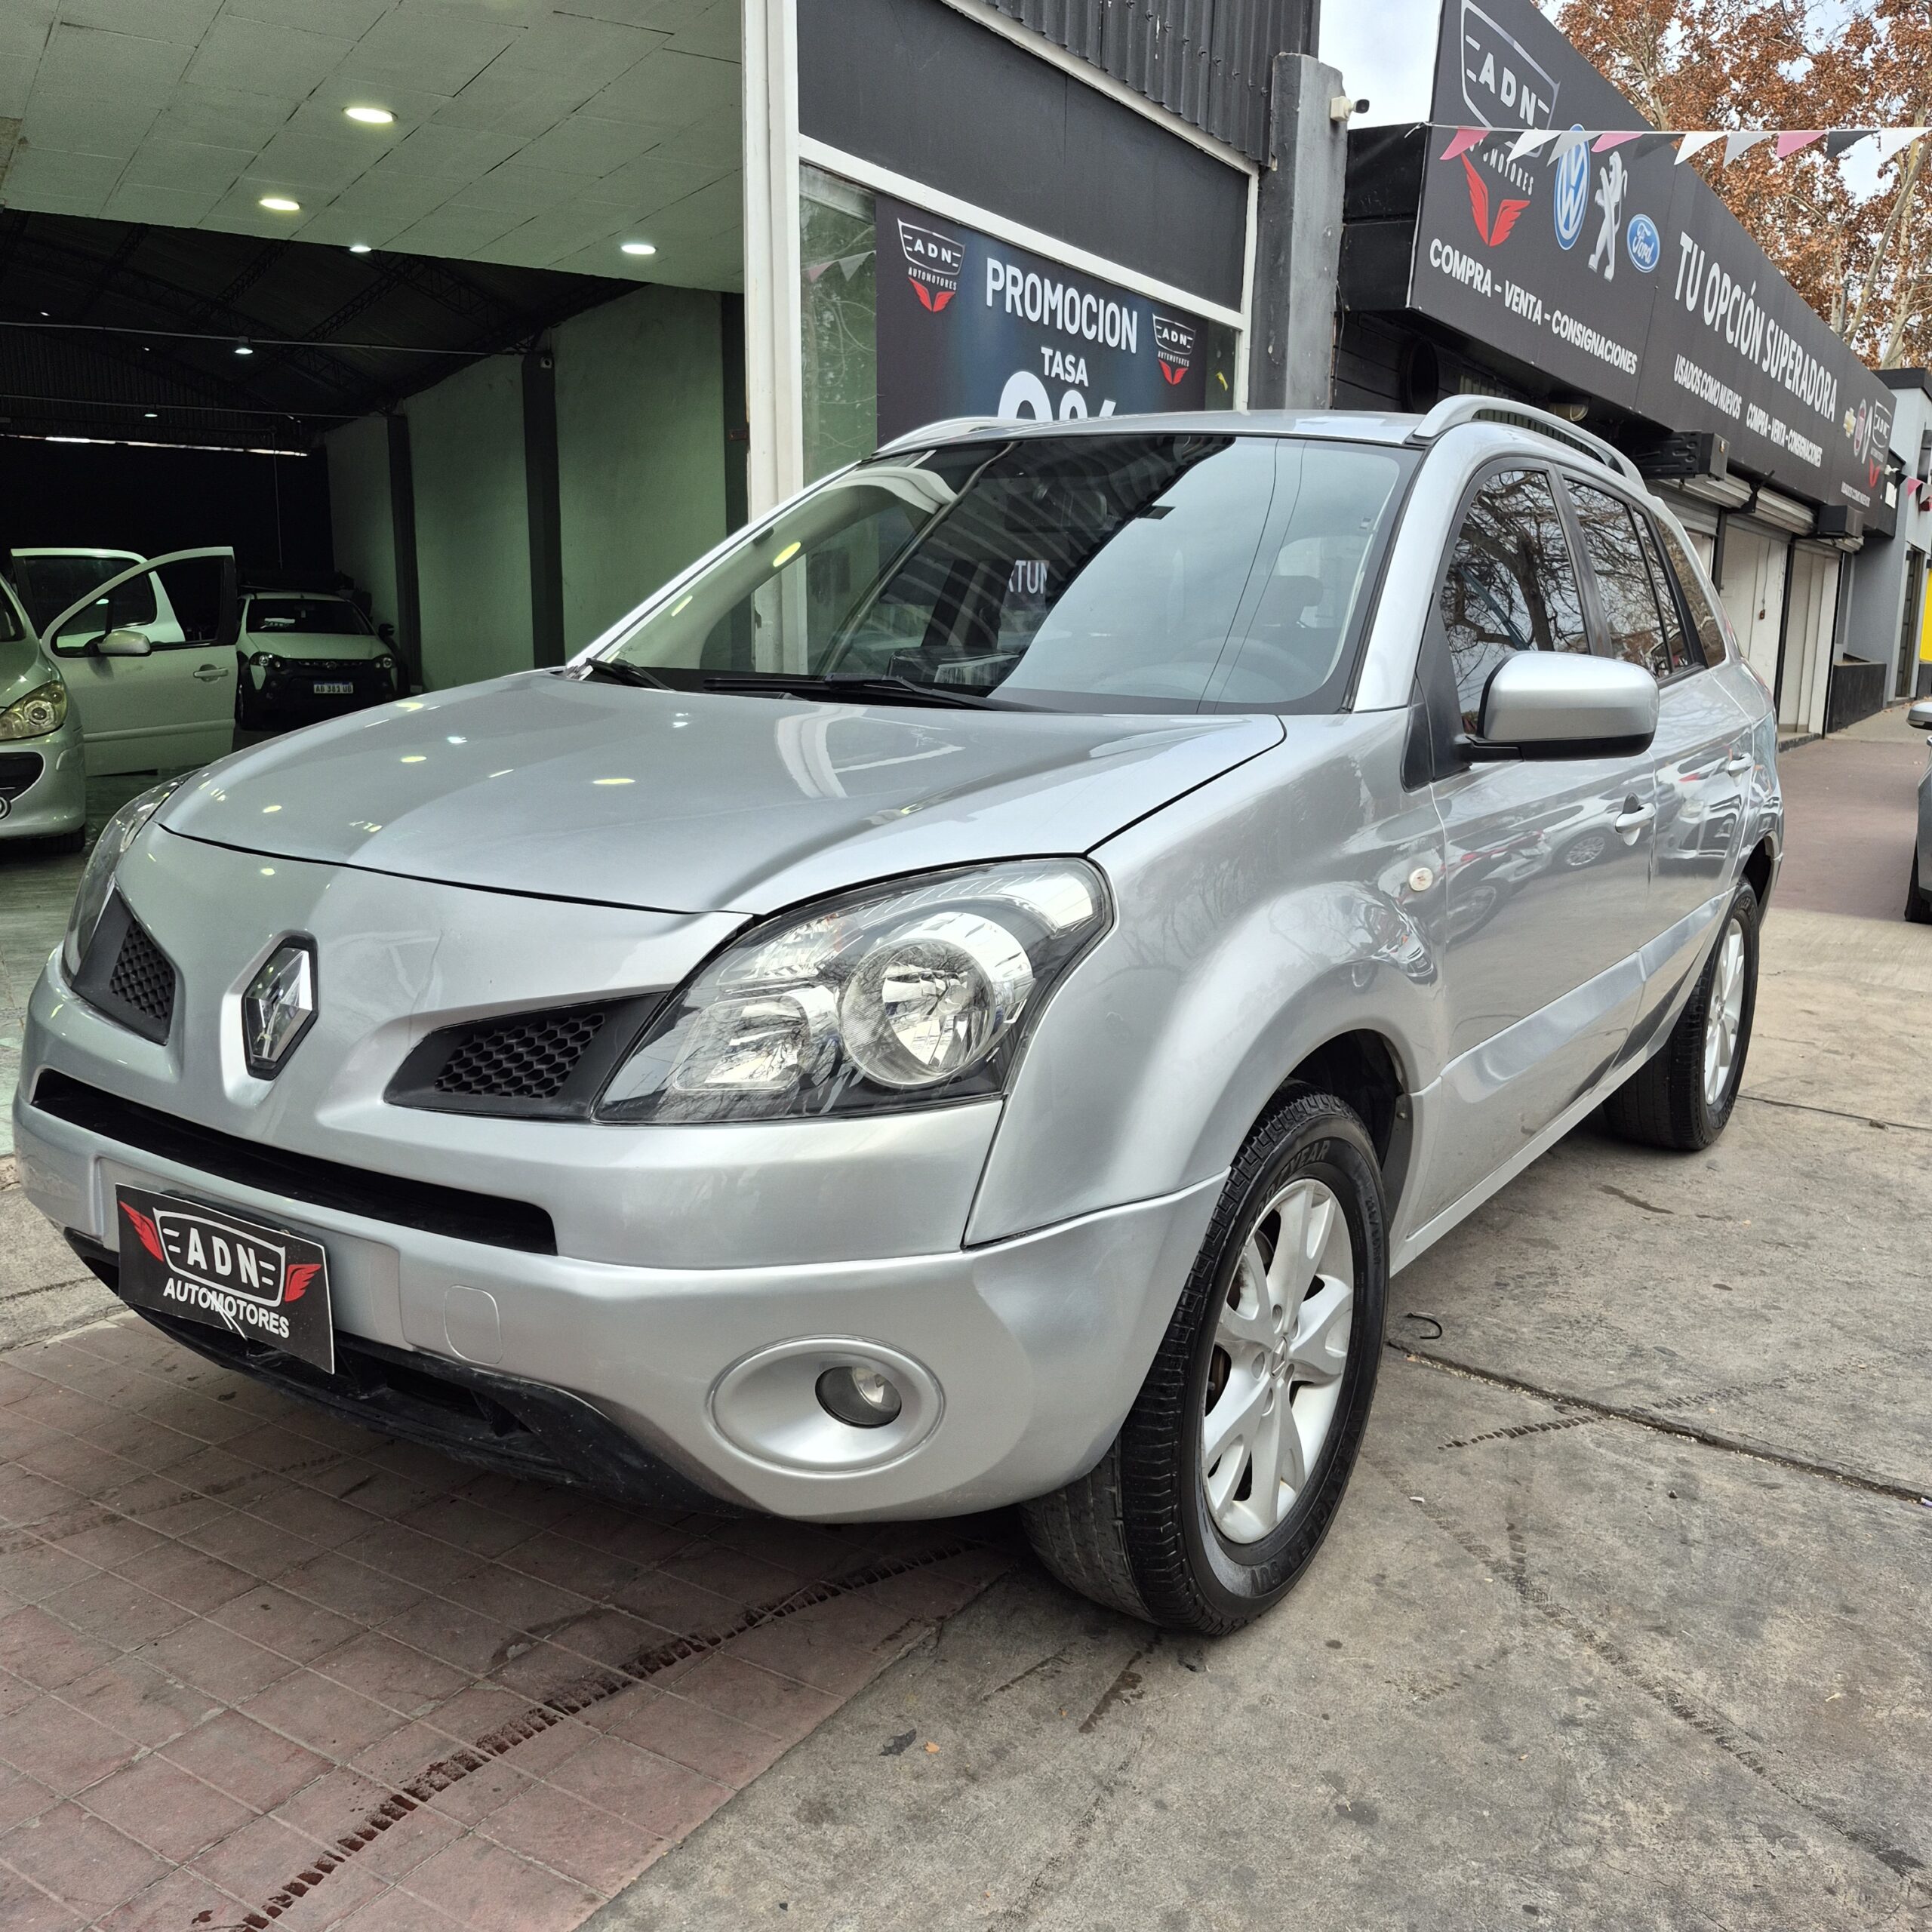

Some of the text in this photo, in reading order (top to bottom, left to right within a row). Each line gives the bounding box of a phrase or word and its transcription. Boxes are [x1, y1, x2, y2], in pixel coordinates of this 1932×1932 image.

[1478, 52, 1537, 127] ADN
[1469, 139, 1534, 195] MOTORES
[914, 238, 952, 263] ADN
[1632, 222, 1655, 264] Ford
[908, 266, 957, 291] AUTOMOTORES
[986, 257, 1138, 354] PROMOCION
[1429, 238, 1492, 297] COMPRA
[1504, 280, 1542, 325] VENTA
[1552, 309, 1638, 375] CONSIGNACIONES
[1162, 328, 1187, 346] ADN
[1675, 231, 1838, 422] TU OPCIÓN SUPERADORA
[1041, 346, 1089, 387] TASA
[1673, 353, 1743, 420] USADOS COMO NUEVOS
[1746, 402, 1769, 438] COMPRA
[187, 1227, 259, 1288] ADN
[163, 1277, 290, 1339] AUTOMOTORES
